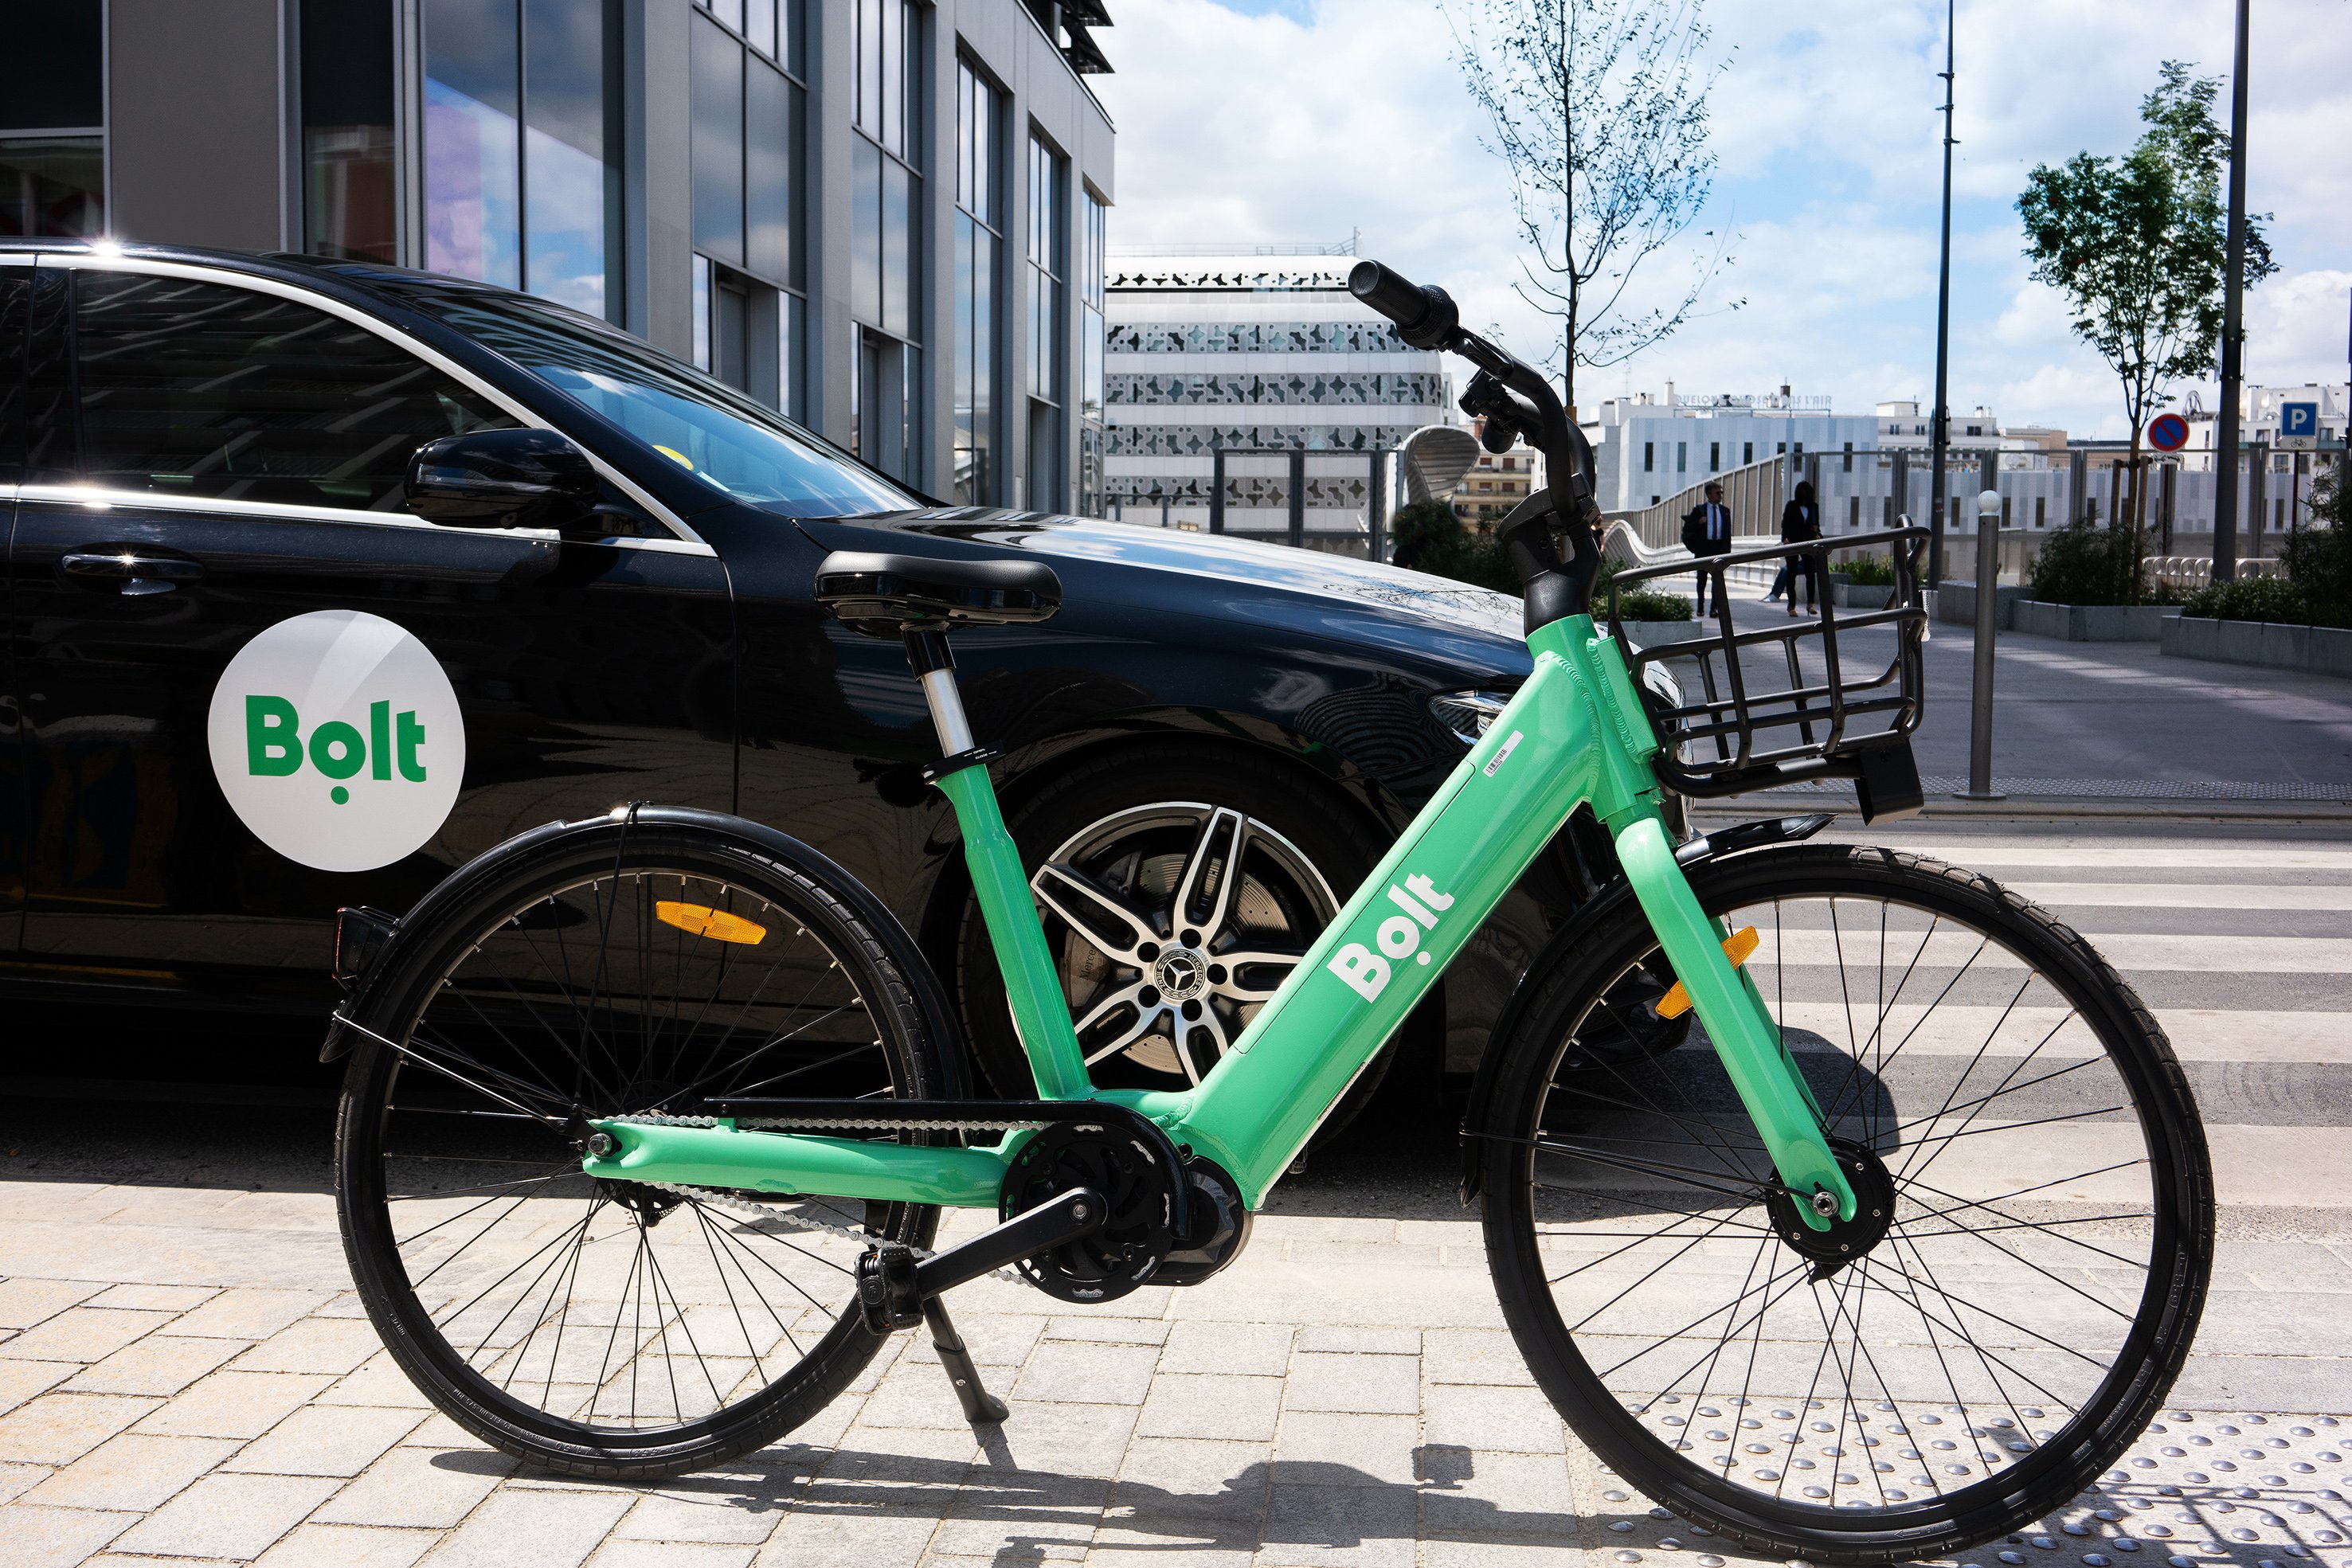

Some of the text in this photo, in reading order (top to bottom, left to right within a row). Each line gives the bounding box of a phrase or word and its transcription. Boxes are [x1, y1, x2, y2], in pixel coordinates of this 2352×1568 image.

[2291, 408, 2307, 431] P
[245, 694, 426, 804] Bolt
[1326, 873, 1455, 1004] Bolt
[1079, 946, 1098, 981] Merce
[1156, 971, 1166, 989] BENZ
[1188, 954, 1203, 987] MERCEDES
